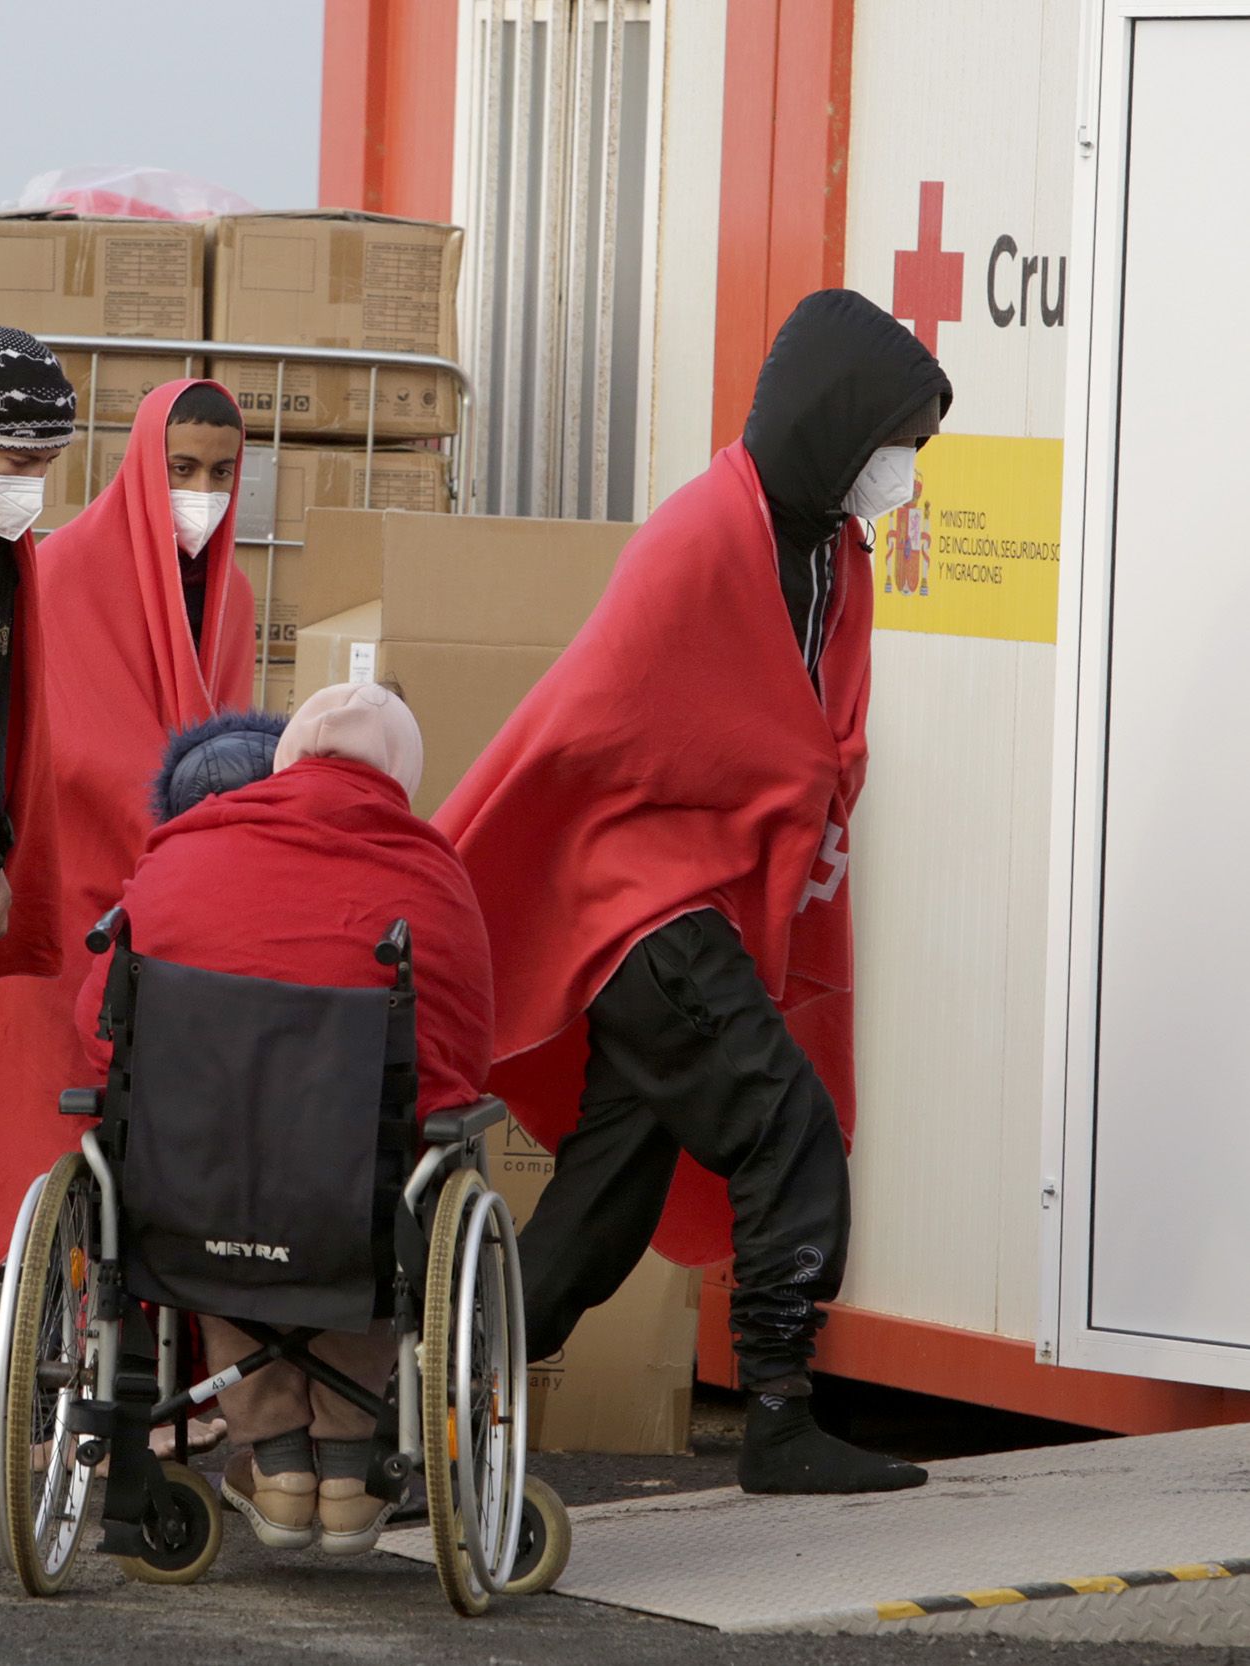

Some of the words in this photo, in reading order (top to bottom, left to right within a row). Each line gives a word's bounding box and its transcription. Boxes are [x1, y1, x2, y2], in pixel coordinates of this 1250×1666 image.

[940, 510, 986, 530] MINISTERIO
[939, 535, 951, 554] DE
[953, 534, 1000, 559] INCLUSIÓN,
[1001, 540, 1049, 560] SEGURIDAD
[938, 562, 944, 579] Y
[946, 563, 1003, 584] MIGRACIONES
[211, 1377, 226, 1391] 43
